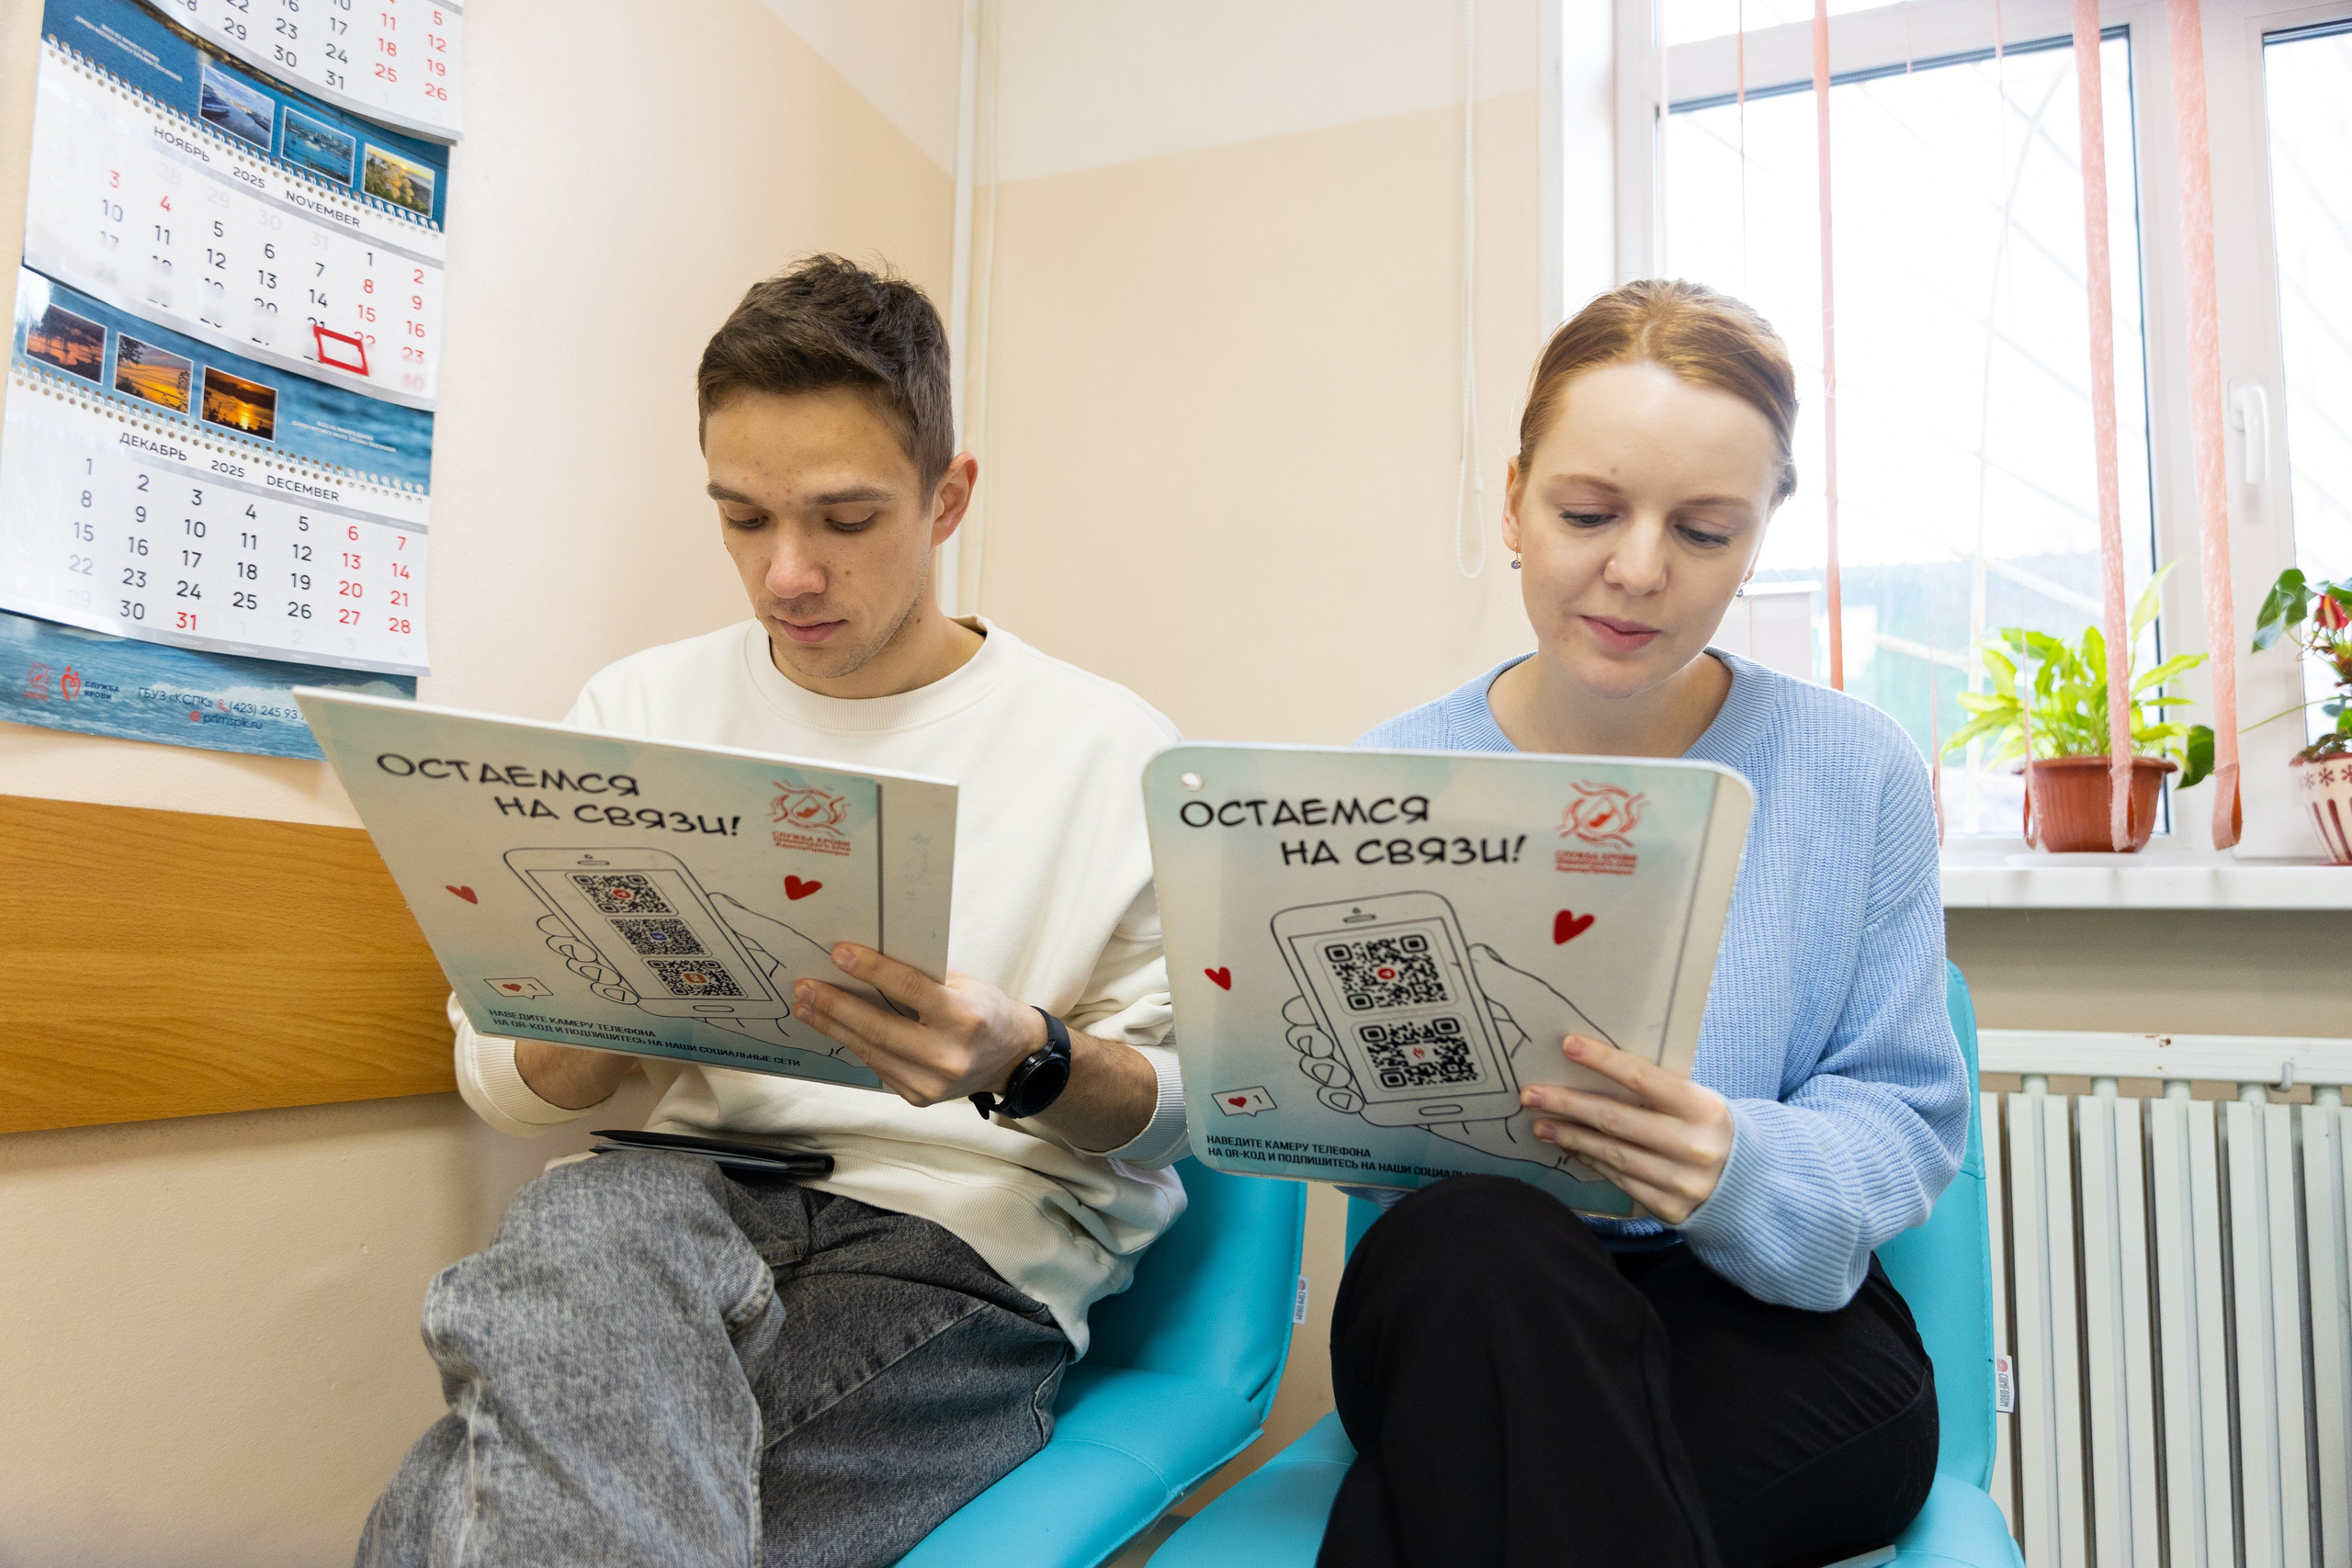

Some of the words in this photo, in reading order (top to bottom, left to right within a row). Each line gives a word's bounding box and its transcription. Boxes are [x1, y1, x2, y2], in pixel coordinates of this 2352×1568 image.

[381, 13, 396, 30] 11
[428, 34, 447, 53] 12
[433, 10, 443, 26] 5
[224, 17, 247, 40] 29
[274, 44, 297, 67] 30
[325, 70, 345, 90] 31
[276, 18, 298, 39] 23
[325, 43, 348, 64] 24
[375, 63, 398, 83] 25
[424, 83, 448, 101] 26
[330, 17, 348, 35] 17
[378, 38, 397, 57] 18
[427, 59, 446, 76] 19
[154, 126, 210, 163] НОЯБРЬ
[232, 169, 266, 188] 2025
[286, 190, 361, 228] NOVEMBER
[109, 169, 120, 188] 3
[160, 196, 171, 212] 4
[213, 220, 223, 238] 5
[265, 243, 276, 259] 6
[315, 262, 324, 277] 7
[364, 278, 374, 294] 8
[412, 295, 422, 310] 9
[257, 209, 282, 231] 30
[311, 231, 329, 250] 31
[367, 253, 373, 266] 1
[413, 269, 424, 285] 2
[103, 199, 123, 222] 10
[155, 225, 171, 245] 11
[207, 248, 227, 269] 12
[257, 269, 277, 289] 13
[309, 288, 328, 309] 14
[357, 304, 376, 322] 15
[406, 321, 425, 338] 16
[119, 432, 187, 461] ДЕКАБРЬ
[211, 460, 245, 478] 2025
[85, 458, 93, 475] 1
[138, 474, 149, 491] 2
[191, 489, 203, 506] 3
[245, 504, 257, 520] 4
[299, 515, 309, 532] 5
[348, 525, 358, 541] 6
[397, 536, 407, 551] 7
[266, 475, 340, 502] DECEMBER
[81, 490, 92, 508] 8
[135, 506, 147, 523] 9
[185, 519, 206, 538] 10
[241, 532, 257, 550] 11
[292, 544, 312, 561] 12
[342, 552, 362, 570] 13
[391, 562, 410, 580] 14
[74, 521, 94, 542] 15
[128, 536, 149, 556] 16
[183, 549, 202, 568] 17
[237, 561, 258, 581] 18
[290, 572, 311, 591] 19
[339, 580, 363, 598] 20
[390, 590, 409, 607] 21
[69, 554, 94, 576] 22
[122, 568, 147, 588] 23
[176, 580, 202, 600] 24
[232, 592, 258, 611] 25
[288, 601, 312, 620] 26
[339, 608, 361, 626] 27
[389, 617, 411, 635] 28
[119, 600, 145, 620] 30
[175, 611, 198, 631] 31
[84, 690, 112, 700] КРОВИ
[85, 681, 119, 692] СЛУЖБА
[138, 687, 166, 701] ГБУЗ
[168, 693, 213, 708] «КСПК»
[230, 701, 257, 716] (423)
[261, 705, 281, 717] 245
[285, 708, 298, 719] 93
[203, 713, 263, 729] primspk.ru
[377, 753, 639, 796] ОСТАЕМСЯ
[494, 795, 560, 819] НА
[573, 803, 741, 836] СВЯЗИ!
[1179, 795, 1430, 828] ОСТАЕМСЯ
[1281, 839, 1340, 865] НА
[1355, 834, 1527, 864] СВЯЗИ!
[489, 1010, 548, 1023] НАВЕДИТЕ
[549, 1017, 594, 1029] КАМЕРУ
[595, 1023, 656, 1038] ТЕЛЕФОНА
[492, 1018, 510, 1026] НА
[511, 1021, 554, 1033] QR-КОД
[564, 1027, 646, 1044] ПОДПИШИТЕСЬ
[665, 1042, 697, 1051] НАШИ
[698, 1046, 773, 1062] СОЦИАЛЬНЫЕ
[774, 1057, 800, 1066] СЕТИ
[1206, 1134, 1262, 1148] НАВЕДИТЕ
[1265, 1140, 1309, 1152] КАМЕРУ
[1311, 1144, 1371, 1157] ТЕЛЕФОНА
[1208, 1147, 1223, 1156] НА
[1225, 1148, 1266, 1161] QR-КОД
[1268, 1153, 1276, 1161] И
[1278, 1153, 1359, 1168] ПОДПИШИТЕСЬ
[1361, 1161, 1375, 1170] НА
[1378, 1165, 1411, 1174] НАШИ
